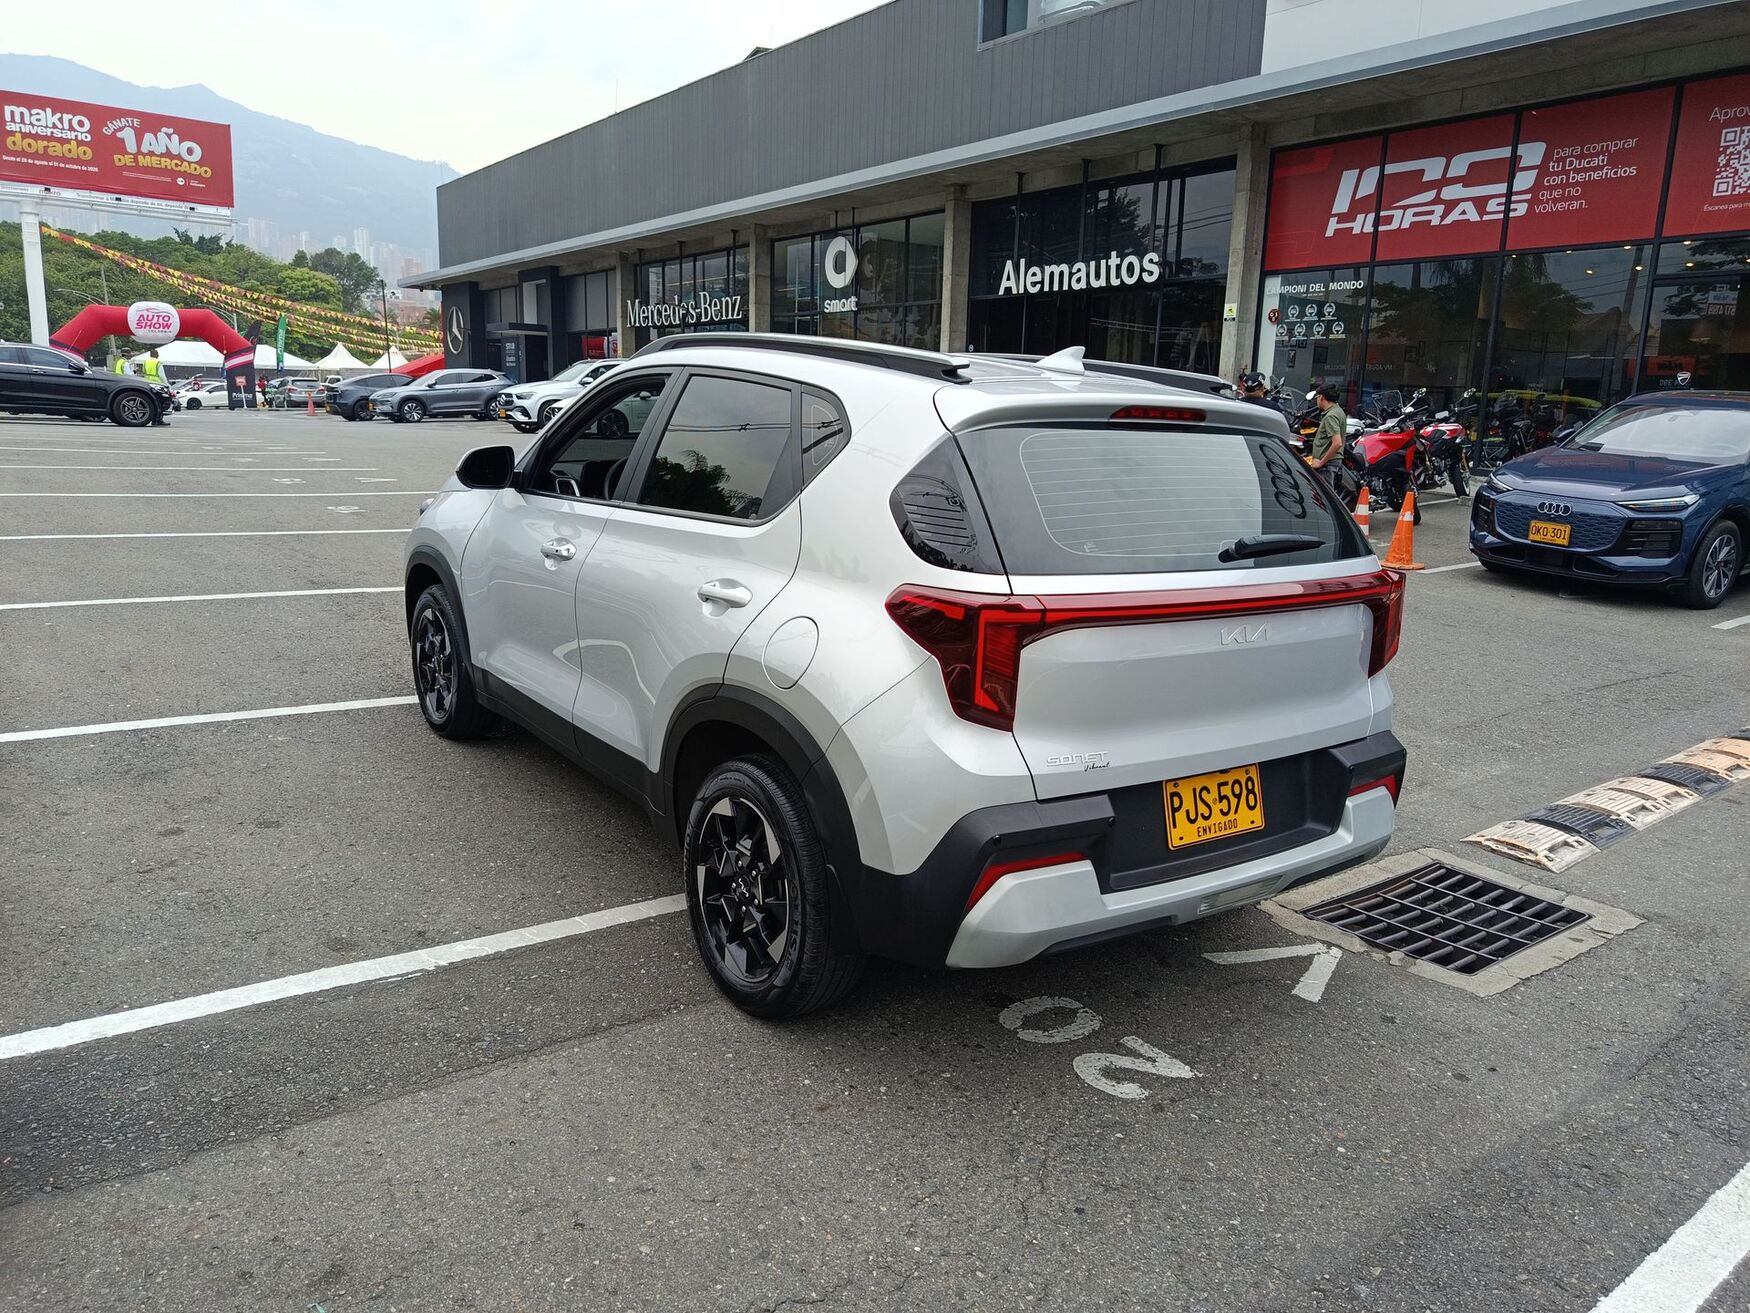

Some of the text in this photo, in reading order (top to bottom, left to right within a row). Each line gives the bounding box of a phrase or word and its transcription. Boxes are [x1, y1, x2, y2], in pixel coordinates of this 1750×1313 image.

[4, 105, 91, 132] makro
[102, 117, 141, 135] GÁNATE
[5, 122, 92, 142] aniversario
[6, 133, 93, 161] dorado
[116, 126, 203, 162] 1 AÑO
[1553, 137, 1640, 162] para comprar
[113, 154, 135, 167] DE
[137, 155, 212, 178] MERCADO
[1549, 153, 1608, 172] tu Ducati
[1543, 164, 1638, 186] con beneficios
[1538, 186, 1583, 203] que no
[1533, 197, 1590, 213] volveran.
[1324, 193, 1533, 239] HORAS
[998, 250, 1161, 296] Alemautos
[1309, 283, 1326, 292] DEL
[1329, 280, 1364, 290] MONDO
[625, 292, 743, 329] Mercedes-Benz
[823, 295, 858, 314] smart
[135, 321, 172, 330] SHOW
[137, 314, 171, 322] AUTO
[1550, 528, 1567, 540] 301
[1219, 621, 1271, 647] KIA
[1046, 751, 1109, 767] SONET
[1196, 817, 1239, 837] ENVIGADO
